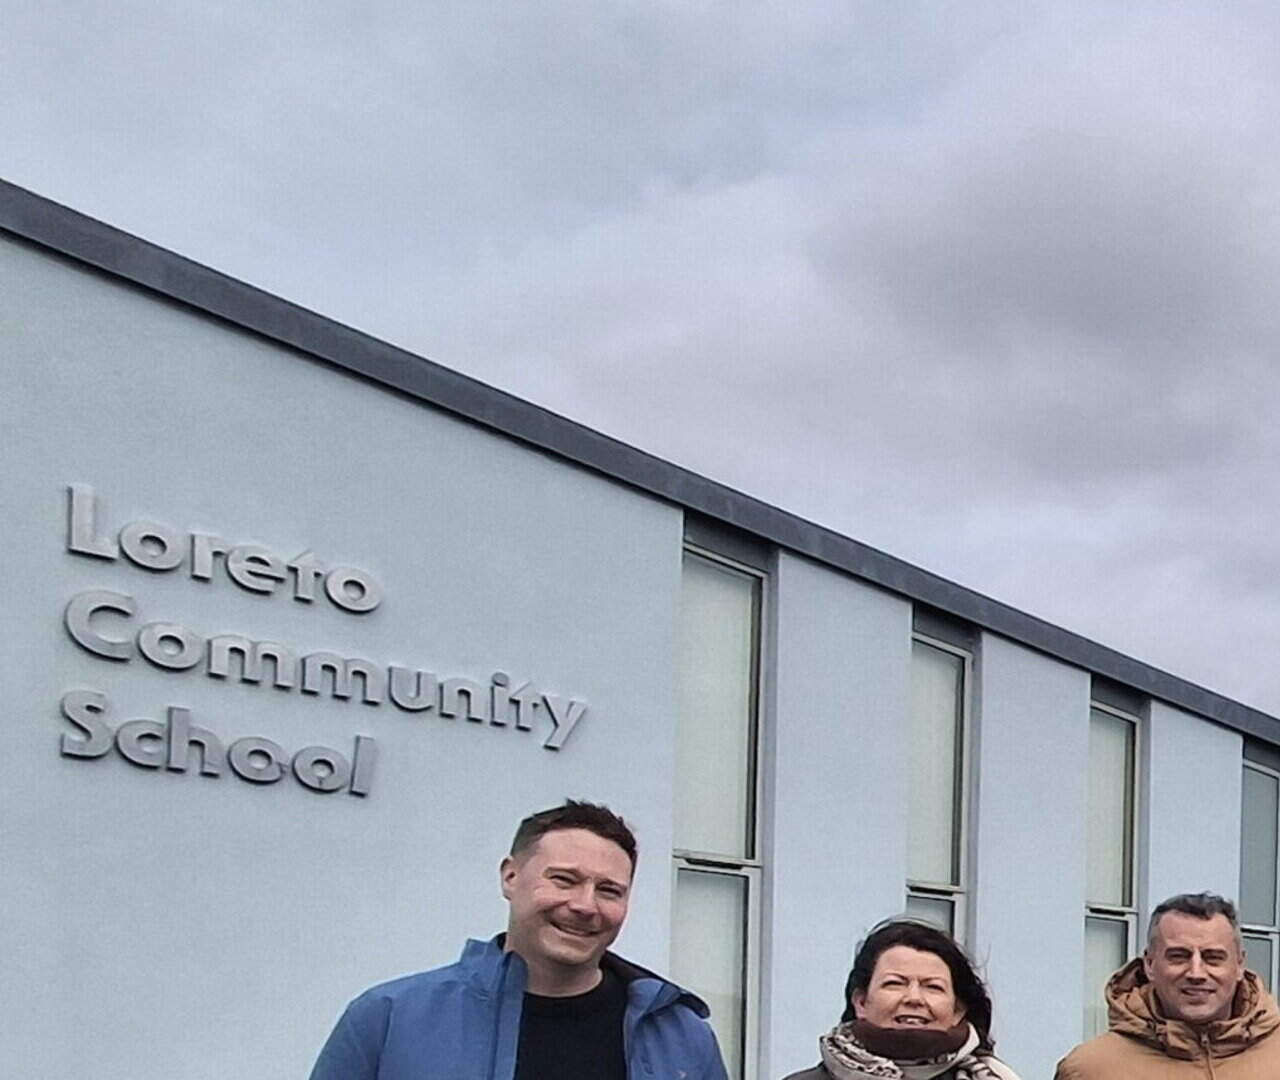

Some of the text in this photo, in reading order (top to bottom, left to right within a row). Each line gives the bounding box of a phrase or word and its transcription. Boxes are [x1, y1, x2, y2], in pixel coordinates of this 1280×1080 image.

[66, 484, 382, 614] Loreto
[64, 590, 588, 751] Community
[60, 690, 379, 798] School
